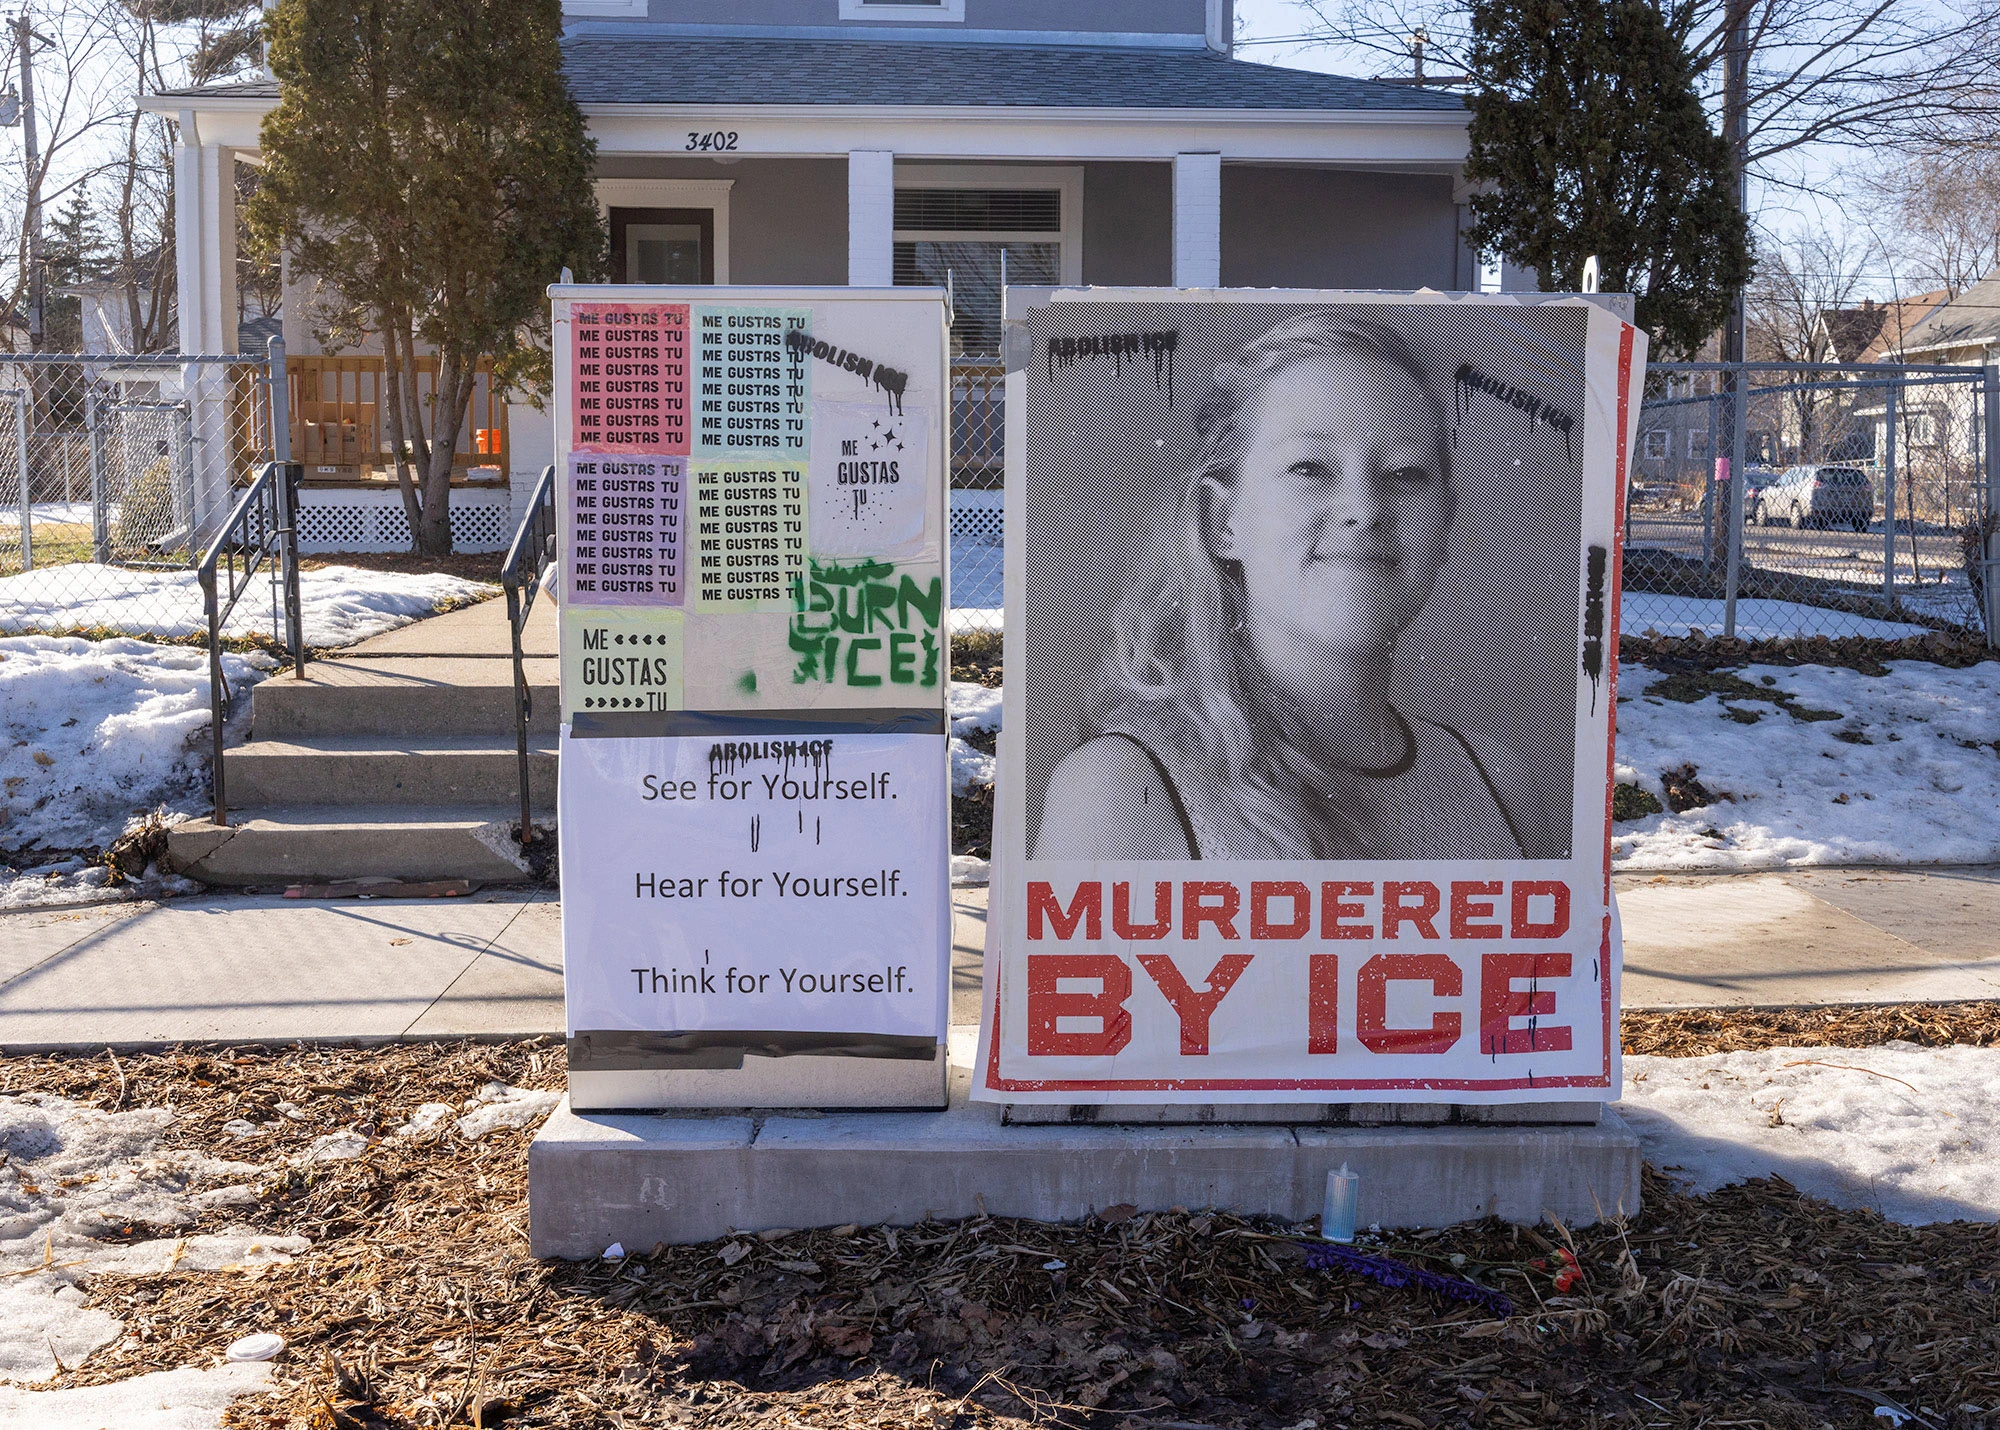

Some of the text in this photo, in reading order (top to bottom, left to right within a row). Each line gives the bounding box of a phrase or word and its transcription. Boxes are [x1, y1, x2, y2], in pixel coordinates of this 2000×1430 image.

[685, 131, 738, 151] 3402
[579, 313, 682, 325] ME GUSTAS TU
[703, 316, 805, 329] ME GUSTAS TU
[580, 330, 682, 342] ME GUSTAS TU
[703, 333, 780, 345] ME GUSTAS
[580, 347, 682, 359] ME GUSTAS TU
[703, 350, 804, 362] ME GUSTAS TU
[580, 364, 682, 376] ME GUSTAS TU
[703, 367, 804, 379] ME GUSTAS TU
[581, 381, 682, 392] ME GUSTAS TU
[703, 384, 803, 397] ME GUSTAS TU
[581, 398, 682, 409] ME GUSTAS TU
[703, 401, 803, 413] ME GUSTAS TU
[581, 415, 682, 426] ME GUSTAS TU
[703, 417, 803, 430] ME GUSTAS TU
[581, 432, 682, 443] ME GUSTAS TU
[702, 434, 802, 447] ME GUSTAS TU
[842, 440, 858, 456] ME
[577, 463, 679, 476] ME GUSTAS TU
[837, 461, 899, 485] GUSTAS
[699, 471, 799, 483] ME GUSTAS TU
[577, 480, 678, 493] ME GUSTAS TU
[700, 488, 799, 500] ME GUSTAS TU
[852, 489, 867, 505] TU
[577, 497, 678, 509] ME GUSTAS TU
[700, 505, 800, 517] ME GUSTAS TU
[577, 513, 677, 526] ME GUSTAS TU
[701, 521, 801, 533] ME GUSTAS TU
[577, 530, 676, 543] ME GUSTAS TU
[701, 538, 801, 550] ME GUSTAS TU
[577, 547, 675, 559] ME GUSTAS TU
[702, 555, 802, 567] ME GUSTAS TU
[577, 564, 675, 576] ME GUSTAS TU
[702, 571, 802, 583] ME GUSTAS TU
[577, 580, 675, 592] ME GUSTAS TU
[703, 590, 721, 600] ME
[728, 588, 779, 599] GUSTAS
[584, 629, 608, 649] ME
[583, 658, 667, 685] GUSTAS
[646, 692, 666, 711] TU
[643, 772, 897, 800] See for Yourself.
[636, 870, 907, 898] Hear for Yourself.
[1028, 881, 1570, 940] MURDERED
[631, 967, 913, 993] Think for Yourself.
[1028, 954, 1572, 1056] BY ICE
